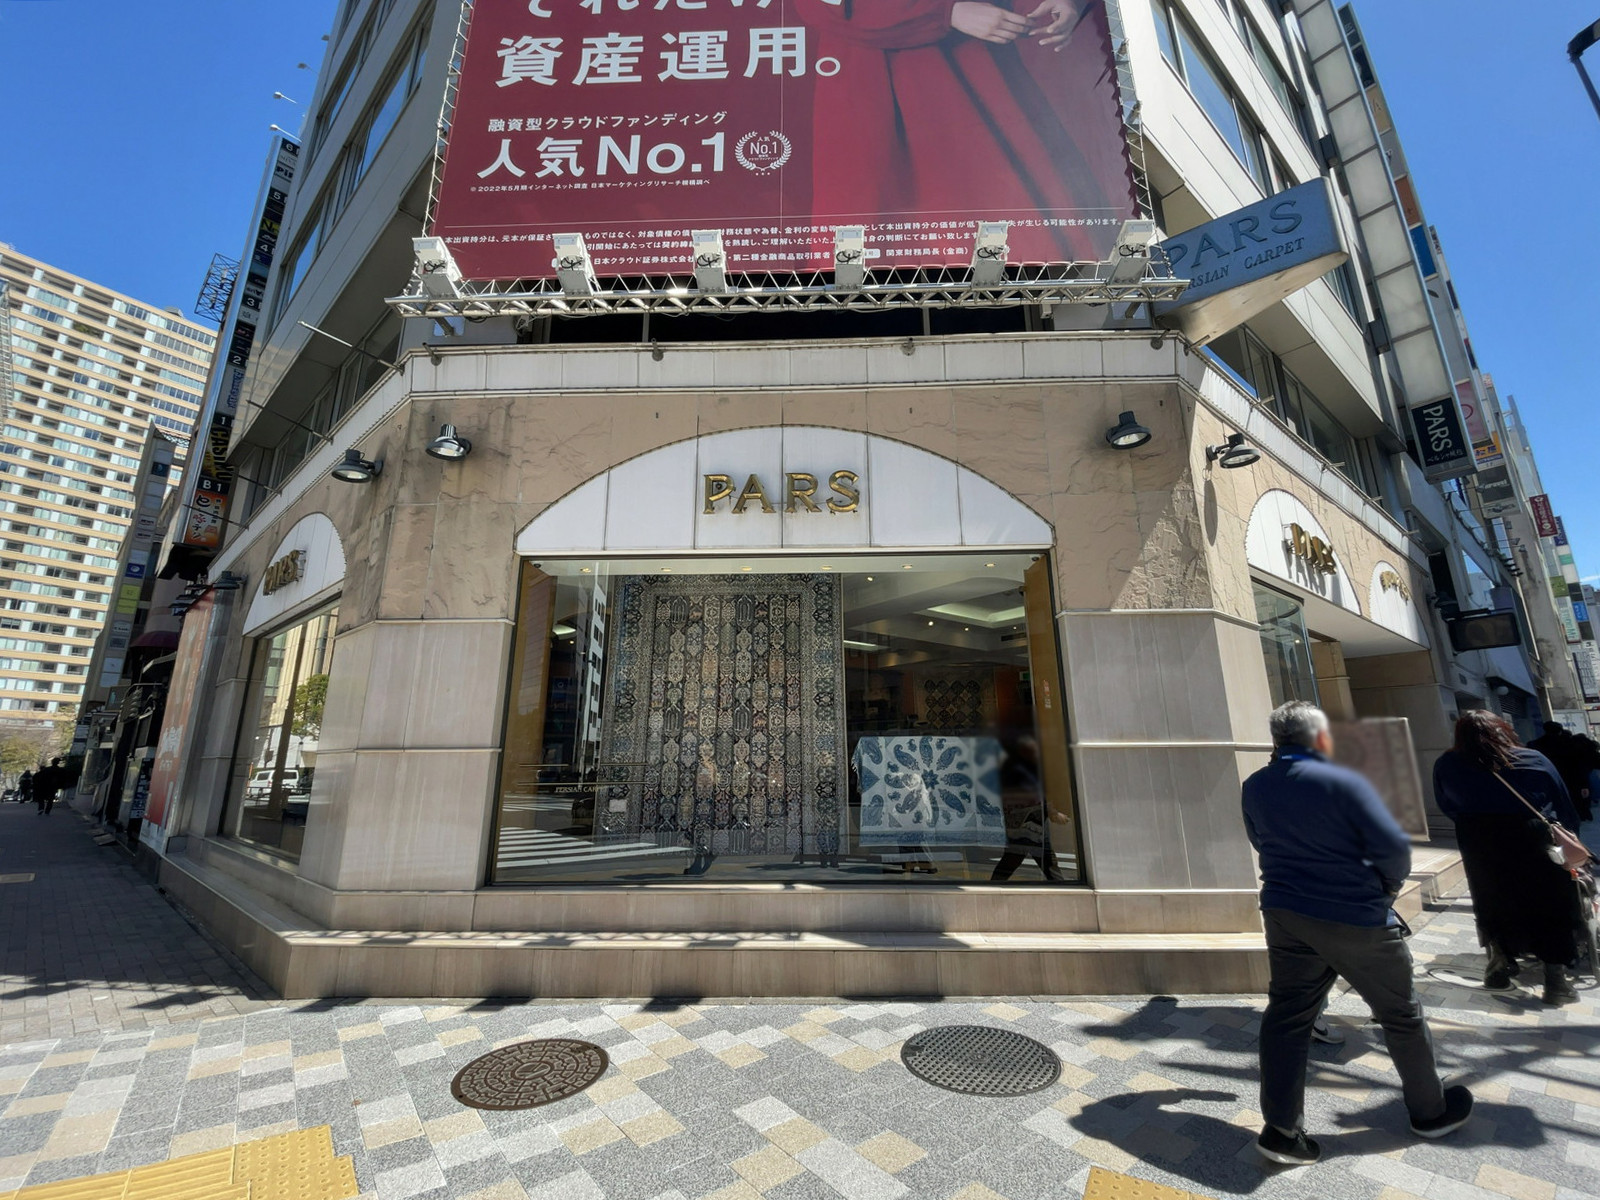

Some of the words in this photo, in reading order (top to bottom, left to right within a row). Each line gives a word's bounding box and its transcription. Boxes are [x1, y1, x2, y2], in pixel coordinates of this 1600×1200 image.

[495, 26, 841, 88] 資産運用。
[488, 111, 728, 132] 融資型クラウドファンディング
[477, 132, 725, 178] 人気No.1
[750, 141, 777, 155] No.1
[1164, 200, 1303, 270] PARS
[1185, 264, 1230, 290] RSIAN
[1244, 237, 1305, 270] CARPET
[1423, 405, 1452, 452] PARS
[703, 470, 860, 514] PARS
